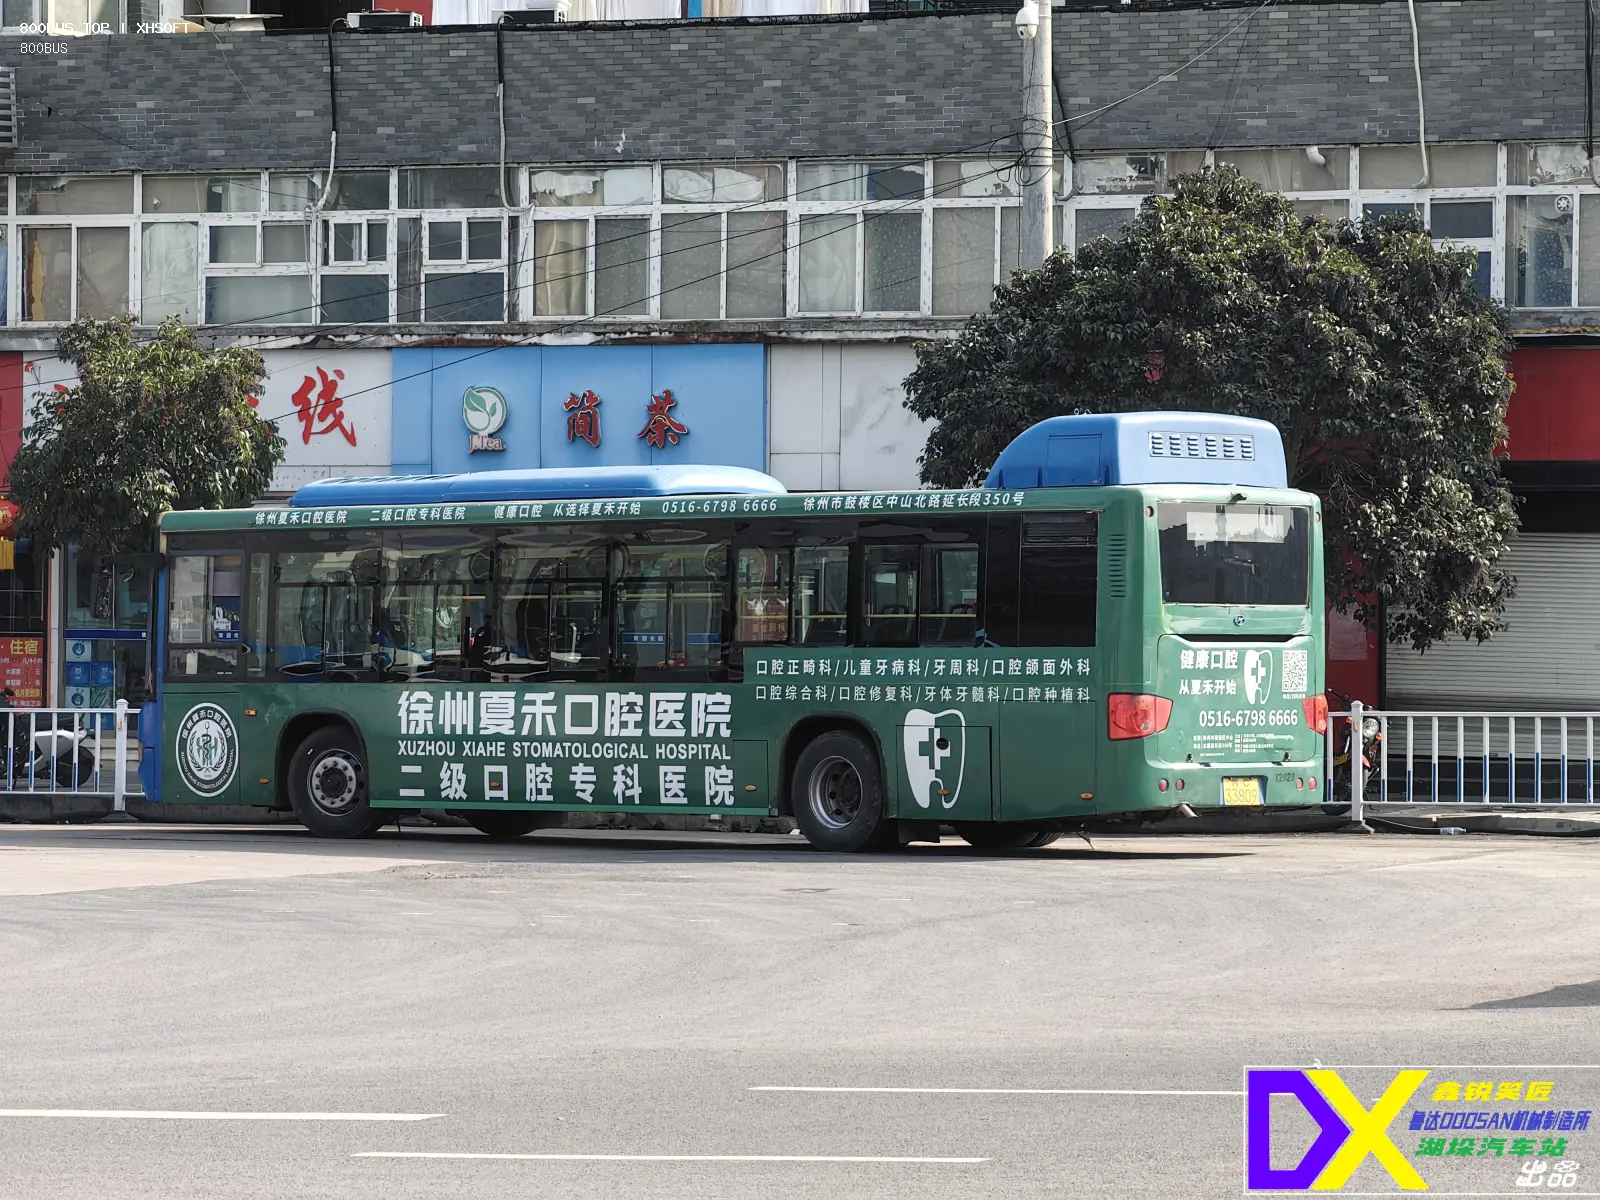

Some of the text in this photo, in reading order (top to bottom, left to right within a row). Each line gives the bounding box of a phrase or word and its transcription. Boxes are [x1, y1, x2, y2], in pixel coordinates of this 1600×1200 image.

[291, 365, 357, 447] 线
[563, 388, 689, 448] 简茶
[255, 492, 1024, 525] 徐州夏禾口腔医院 二级口腔专科医院 健康口腔 从选择夏禾开始 0516-6798 6666 徐州市鼓楼区中山北路延长段350号
[10, 639, 38, 655] 住宿
[756, 658, 1091, 677] 口腔正畸科/儿童牙病科/牙周科/口腔颌面外科
[1180, 650, 1238, 670] 健康口腔
[756, 685, 1090, 704] 口腔综合科/口腔修复科/牙体牙髓科/口腔种植科
[1178, 679, 1237, 695] 从夏禾开始
[397, 690, 732, 738] 徐州夏禾口腔医院
[1199, 708, 1298, 727] 0516-6798 6666
[398, 740, 732, 760] XUZHOU XIAHE STOMATOLOGICAL HOSPITAL
[399, 761, 735, 806] 二级口腔专科医院
[1225, 788, 1258, 803] 33809
